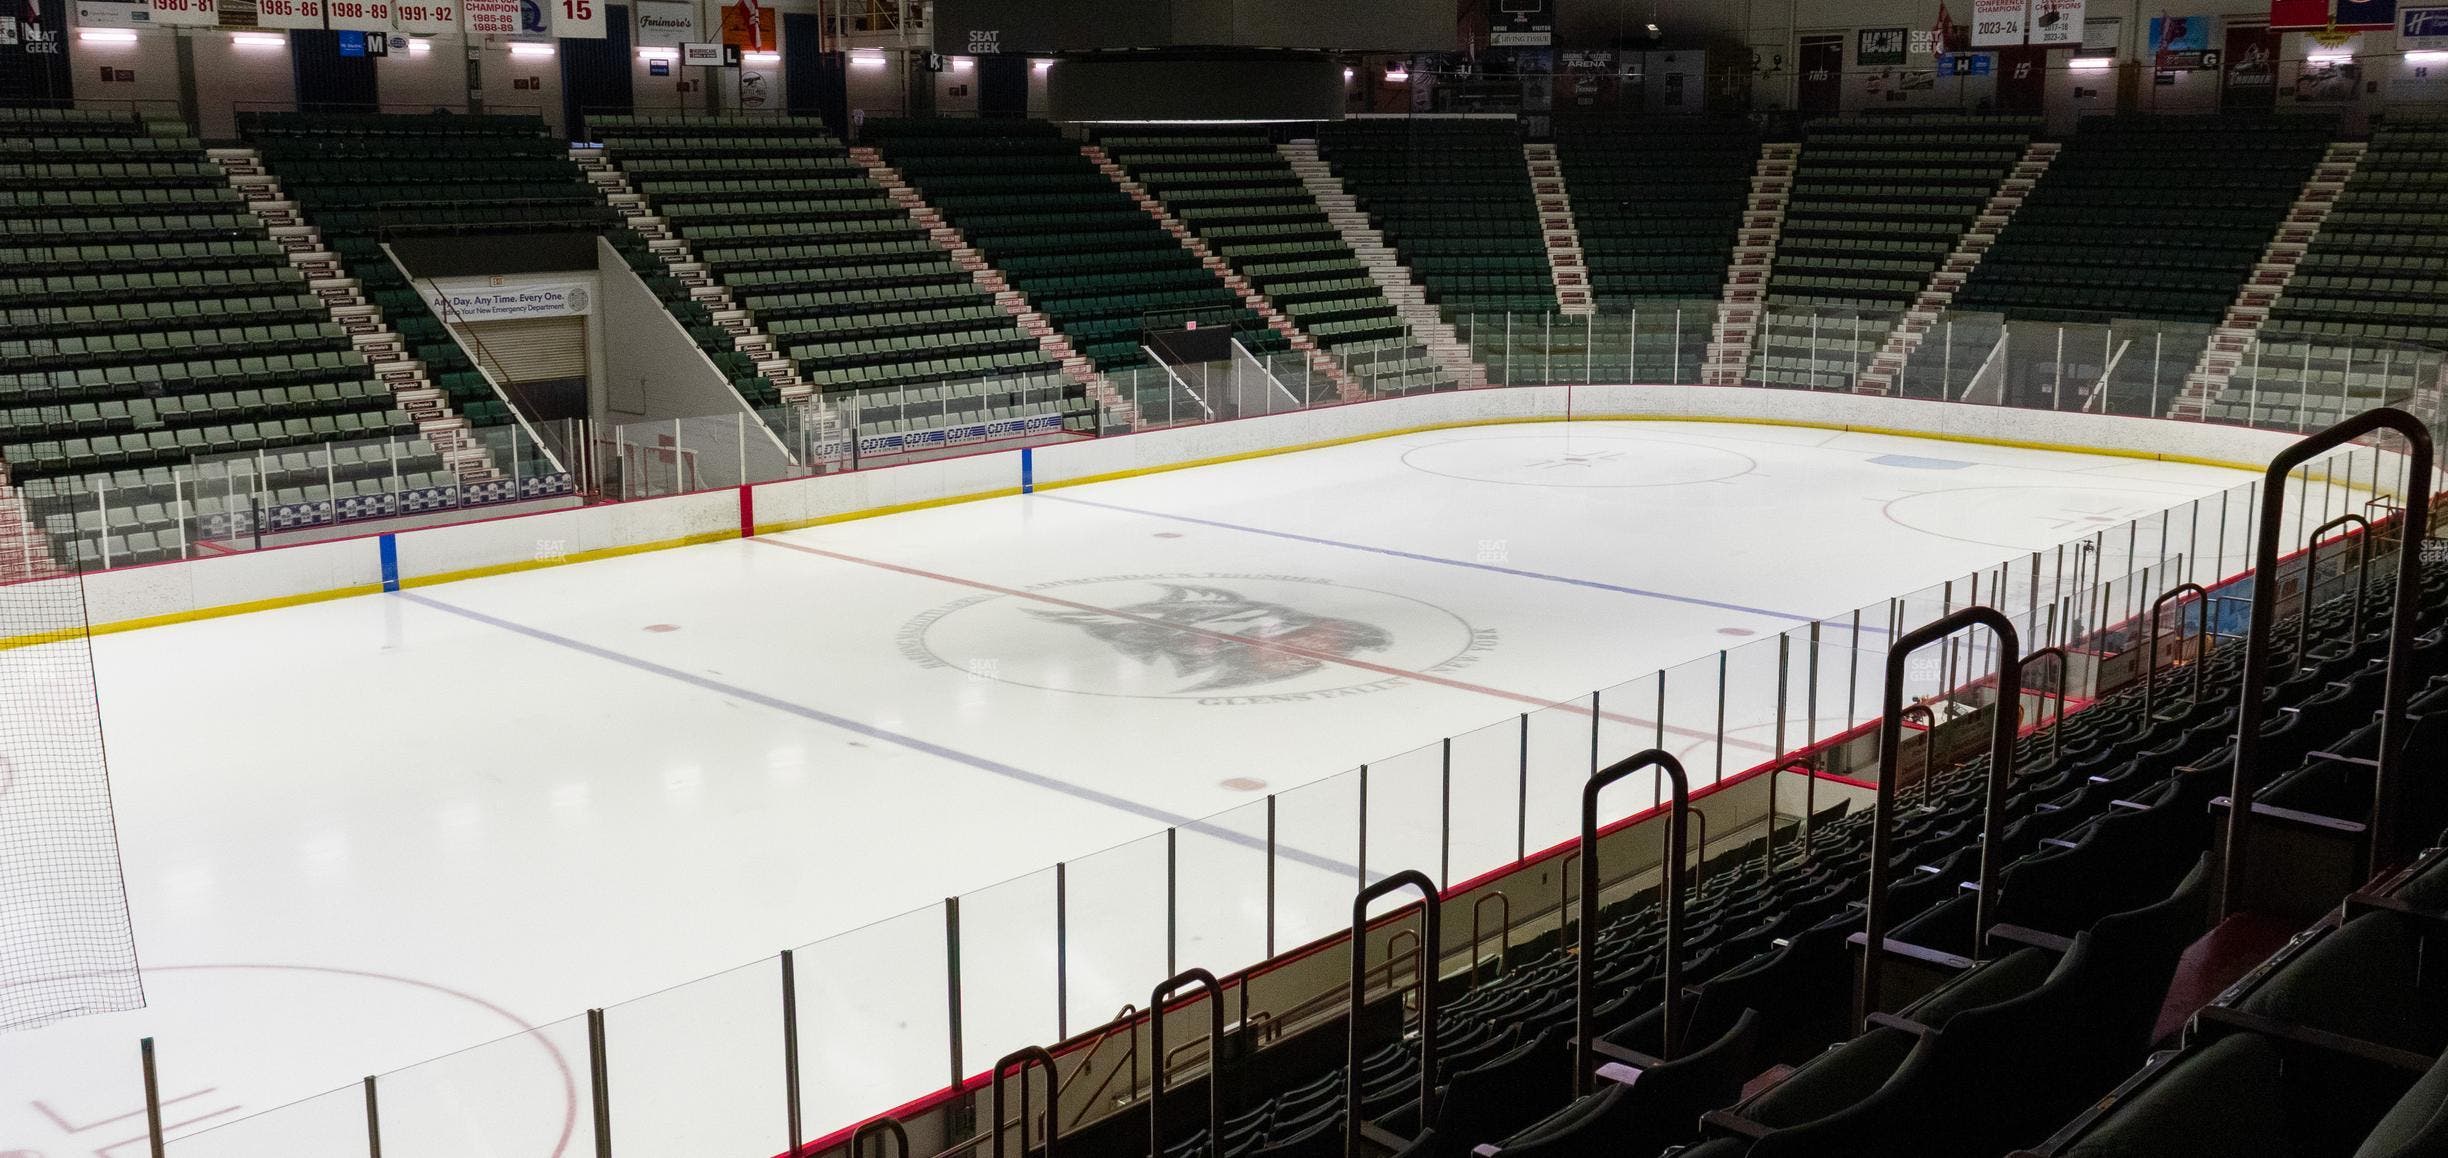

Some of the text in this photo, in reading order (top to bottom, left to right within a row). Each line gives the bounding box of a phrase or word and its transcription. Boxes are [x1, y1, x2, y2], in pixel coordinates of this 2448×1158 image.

[153, 0, 214, 12] 1980-81
[260, 0, 318, 16] 1985-86
[332, 3, 387, 19] 1988-89
[466, 3, 518, 12] CHAMPION
[563, 1, 592, 20] 15
[1977, 5, 2022, 14] CHAMPIONS
[399, 6, 452, 21] 1991-92
[473, 14, 512, 23] 1985-86
[474, 23, 513, 31] 1988-89
[1978, 22, 2017, 35] 2023-24
[367, 36, 384, 53] M
[727, 48, 738, 63] L
[930, 54, 941, 70] K
[2203, 54, 2217, 67] G
[1957, 59, 1970, 72] H
[453, 297, 472, 307] Day.
[474, 296, 492, 306] Any
[493, 295, 518, 304] Time.
[520, 294, 543, 303] Every
[544, 292, 565, 301] One.
[492, 306, 528, 314] Emergency
[528, 303, 565, 312] Department
[988, 422, 1017, 434] CDTA
[1026, 417, 1055, 429] CDTA
[904, 431, 936, 445] CDTA
[947, 427, 978, 440] CDTA
[815, 443, 843, 456] CDT
[861, 437, 893, 451] CDTA
[1197, 693, 1312, 706] GLENS
